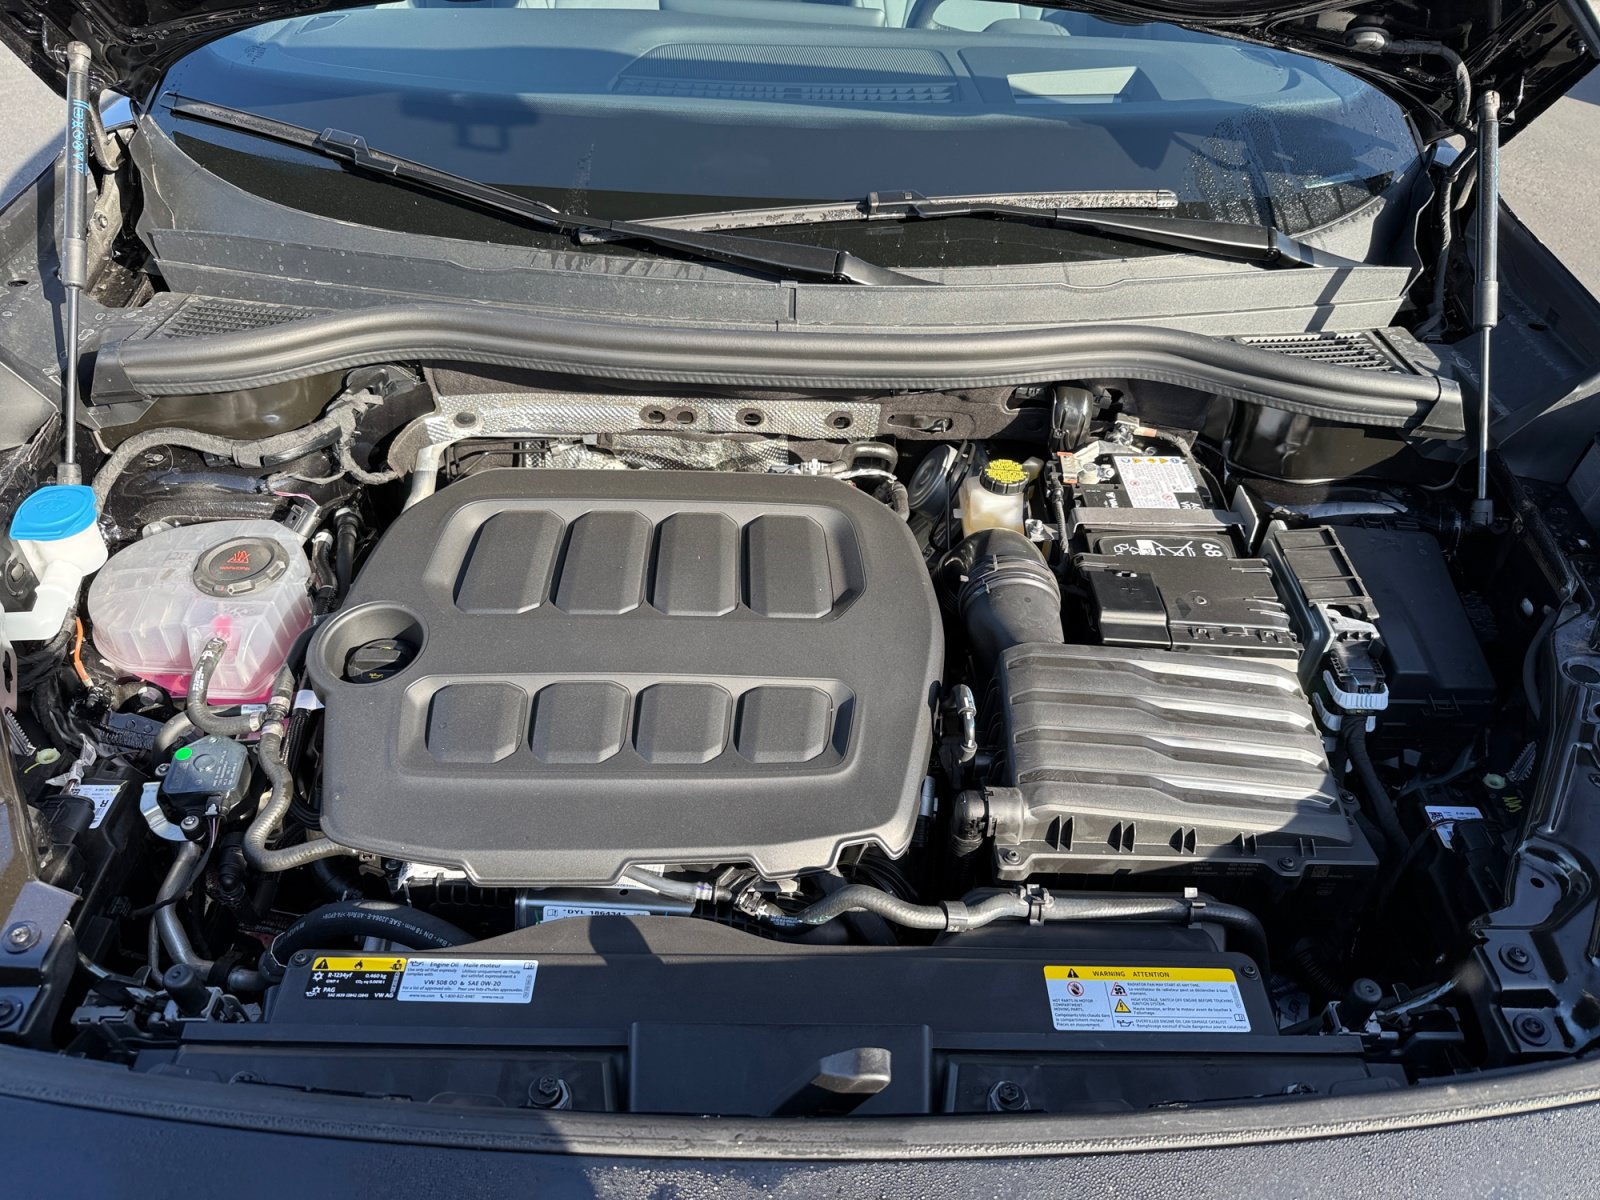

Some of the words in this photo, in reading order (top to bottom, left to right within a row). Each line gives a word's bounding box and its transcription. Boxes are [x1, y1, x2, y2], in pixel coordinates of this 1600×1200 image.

[1201, 542, 1224, 557] 68
[390, 918, 402, 927] SAE
[423, 931, 434, 940] DN
